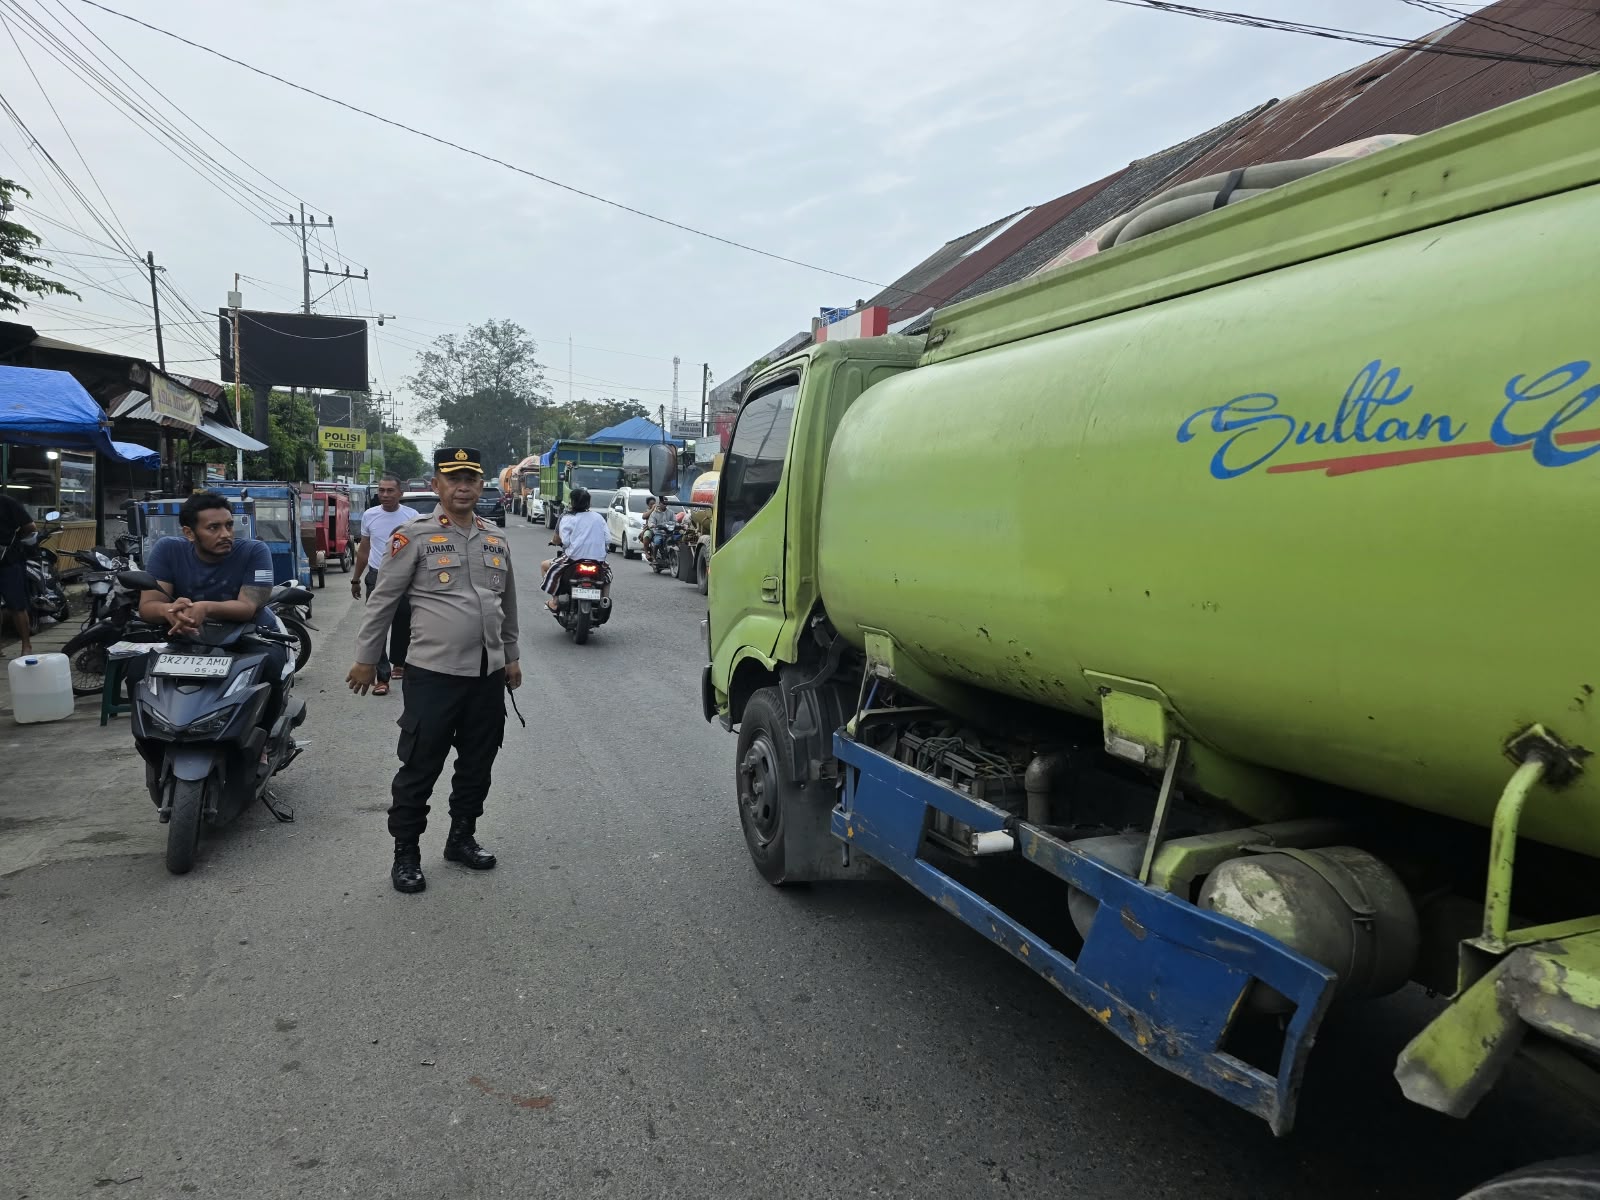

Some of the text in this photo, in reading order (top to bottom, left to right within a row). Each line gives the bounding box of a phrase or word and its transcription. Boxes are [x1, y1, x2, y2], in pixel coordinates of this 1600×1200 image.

[1176, 359, 1466, 479] Sultan
[324, 432, 361, 442] POLISI
[426, 544, 456, 554] JUNAIDI
